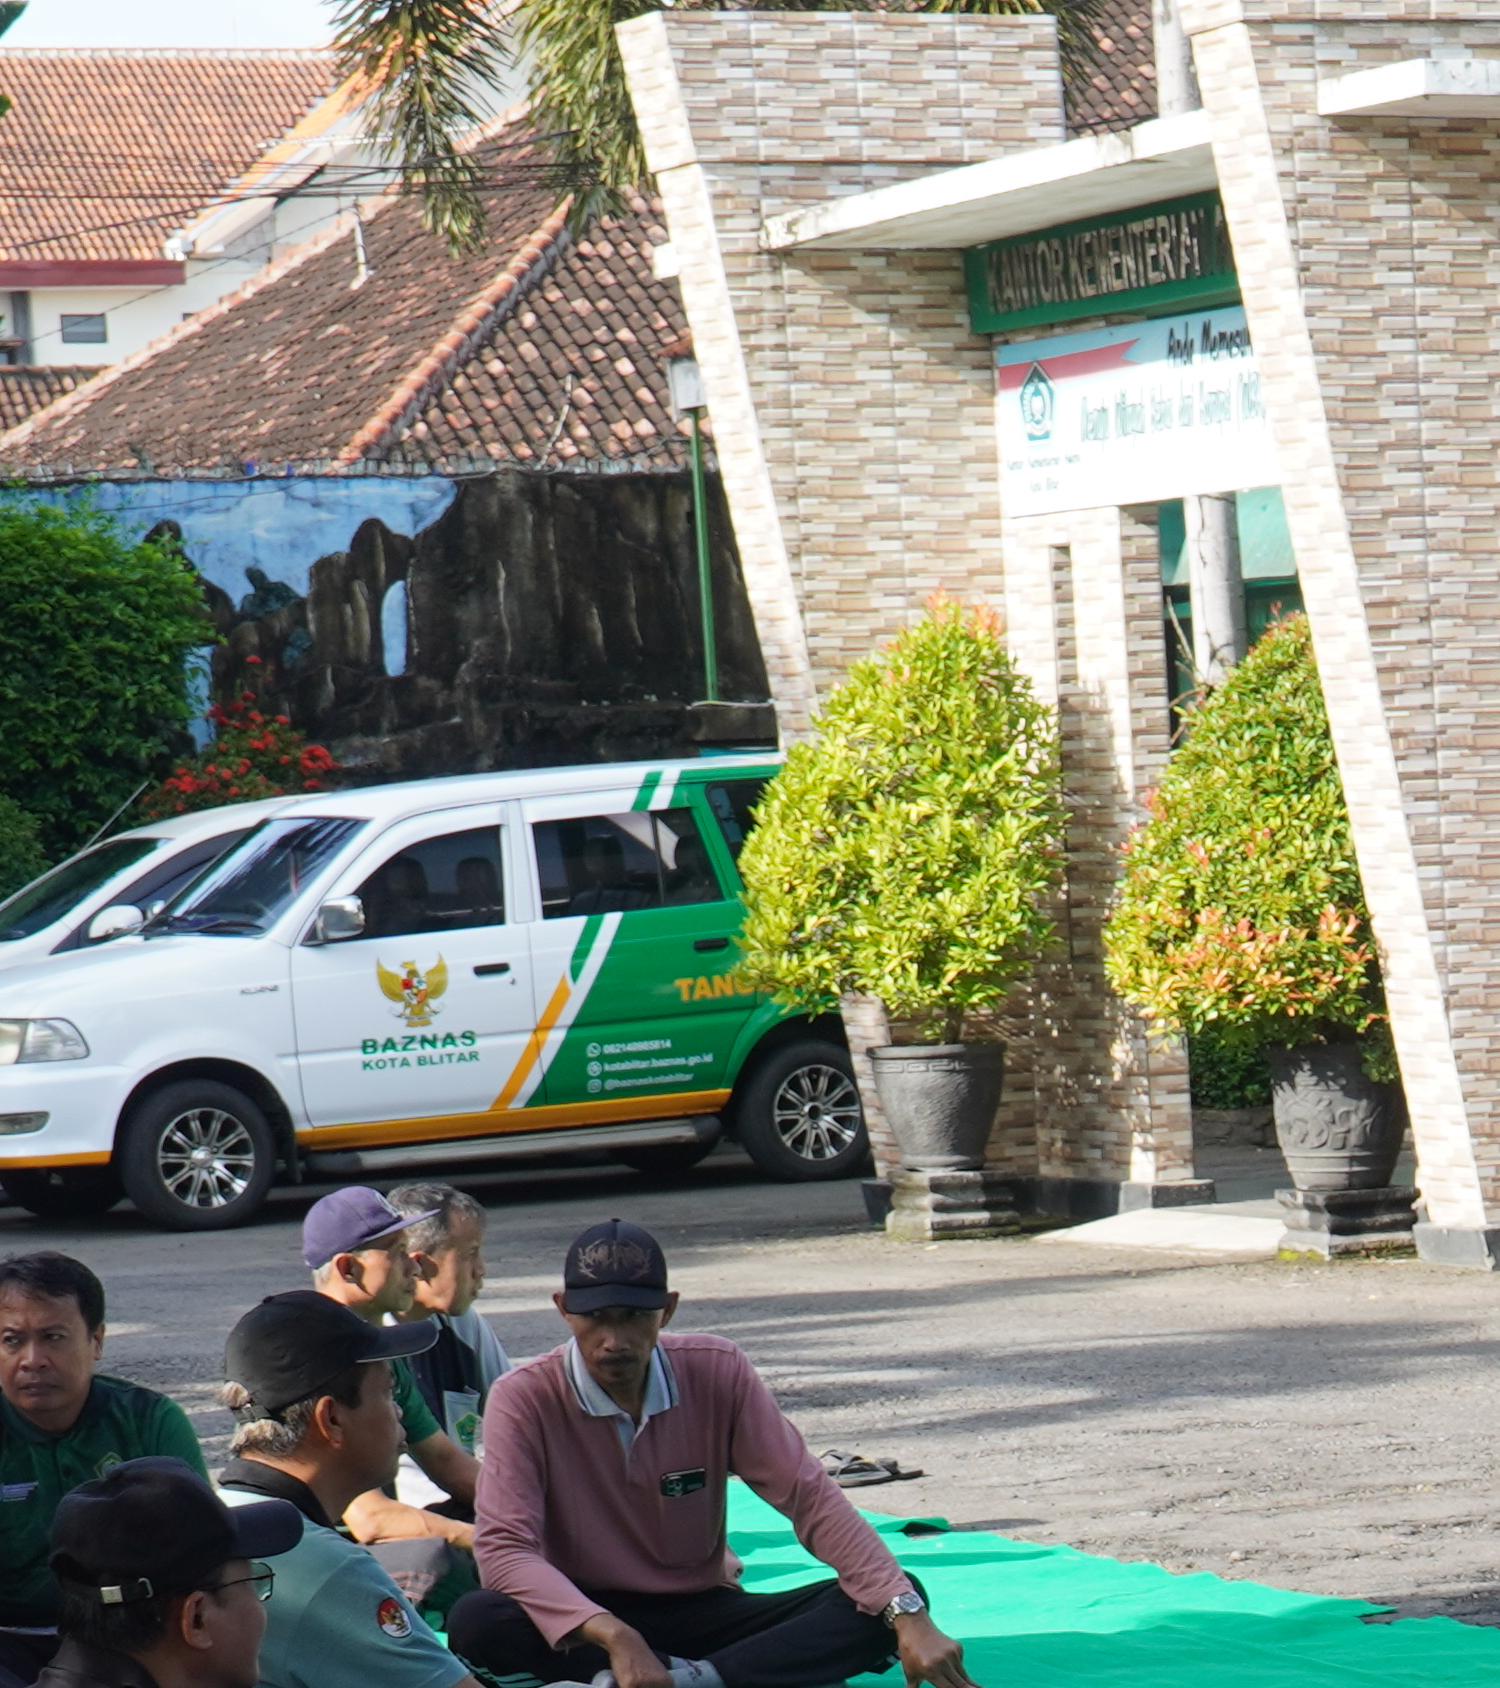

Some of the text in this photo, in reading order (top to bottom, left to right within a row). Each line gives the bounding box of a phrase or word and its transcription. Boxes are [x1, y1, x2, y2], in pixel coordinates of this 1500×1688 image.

[361, 1030, 478, 1056] BAZNAS
[362, 1051, 481, 1072] KOTA BLITAR
